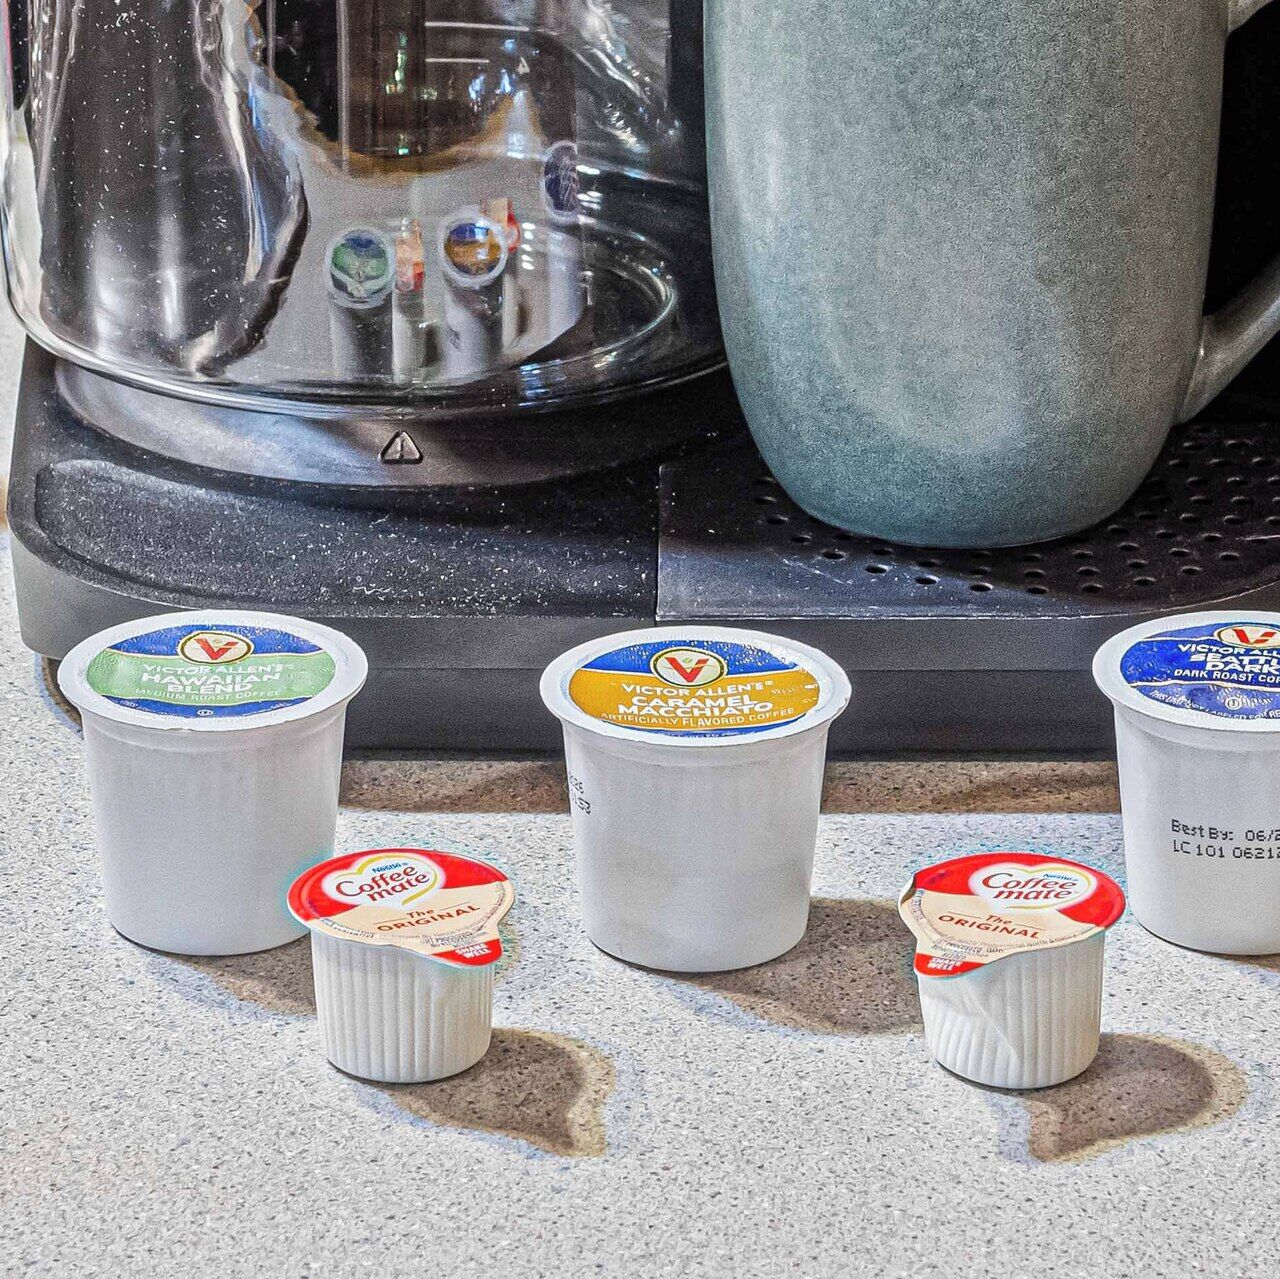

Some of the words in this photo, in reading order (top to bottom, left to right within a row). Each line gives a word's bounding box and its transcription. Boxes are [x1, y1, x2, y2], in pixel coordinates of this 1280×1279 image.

[1178, 643, 1248, 656] VICTOR
[143, 663, 212, 676] VICTOR
[1174, 668, 1209, 678] DARK
[1213, 671, 1254, 682] ROAST
[142, 670, 281, 687] HAWAIIAN
[168, 681, 254, 694] BLEND
[620, 682, 692, 697] VICTOR
[696, 680, 764, 696] ALLEN'S
[631, 695, 760, 708] CARAMEL
[600, 712, 678, 726] ARTIFICIALLY
[682, 716, 745, 727] FLAVORED
[748, 707, 794, 723] COFFEE
[618, 702, 774, 718] MACCHIATO
[1170, 818, 1205, 838] Best
[1208, 827, 1234, 842] By:
[335, 862, 419, 898] Coffee
[366, 872, 430, 903] mate
[982, 872, 1078, 891] Coffee
[994, 888, 1073, 901] mate
[376, 904, 480, 933] ORIGINAL
[408, 908, 434, 922] The
[985, 914, 1013, 926] The
[938, 914, 1045, 940] ORIGINAL
[462, 948, 492, 960] WELL
[926, 962, 955, 972] WELL
